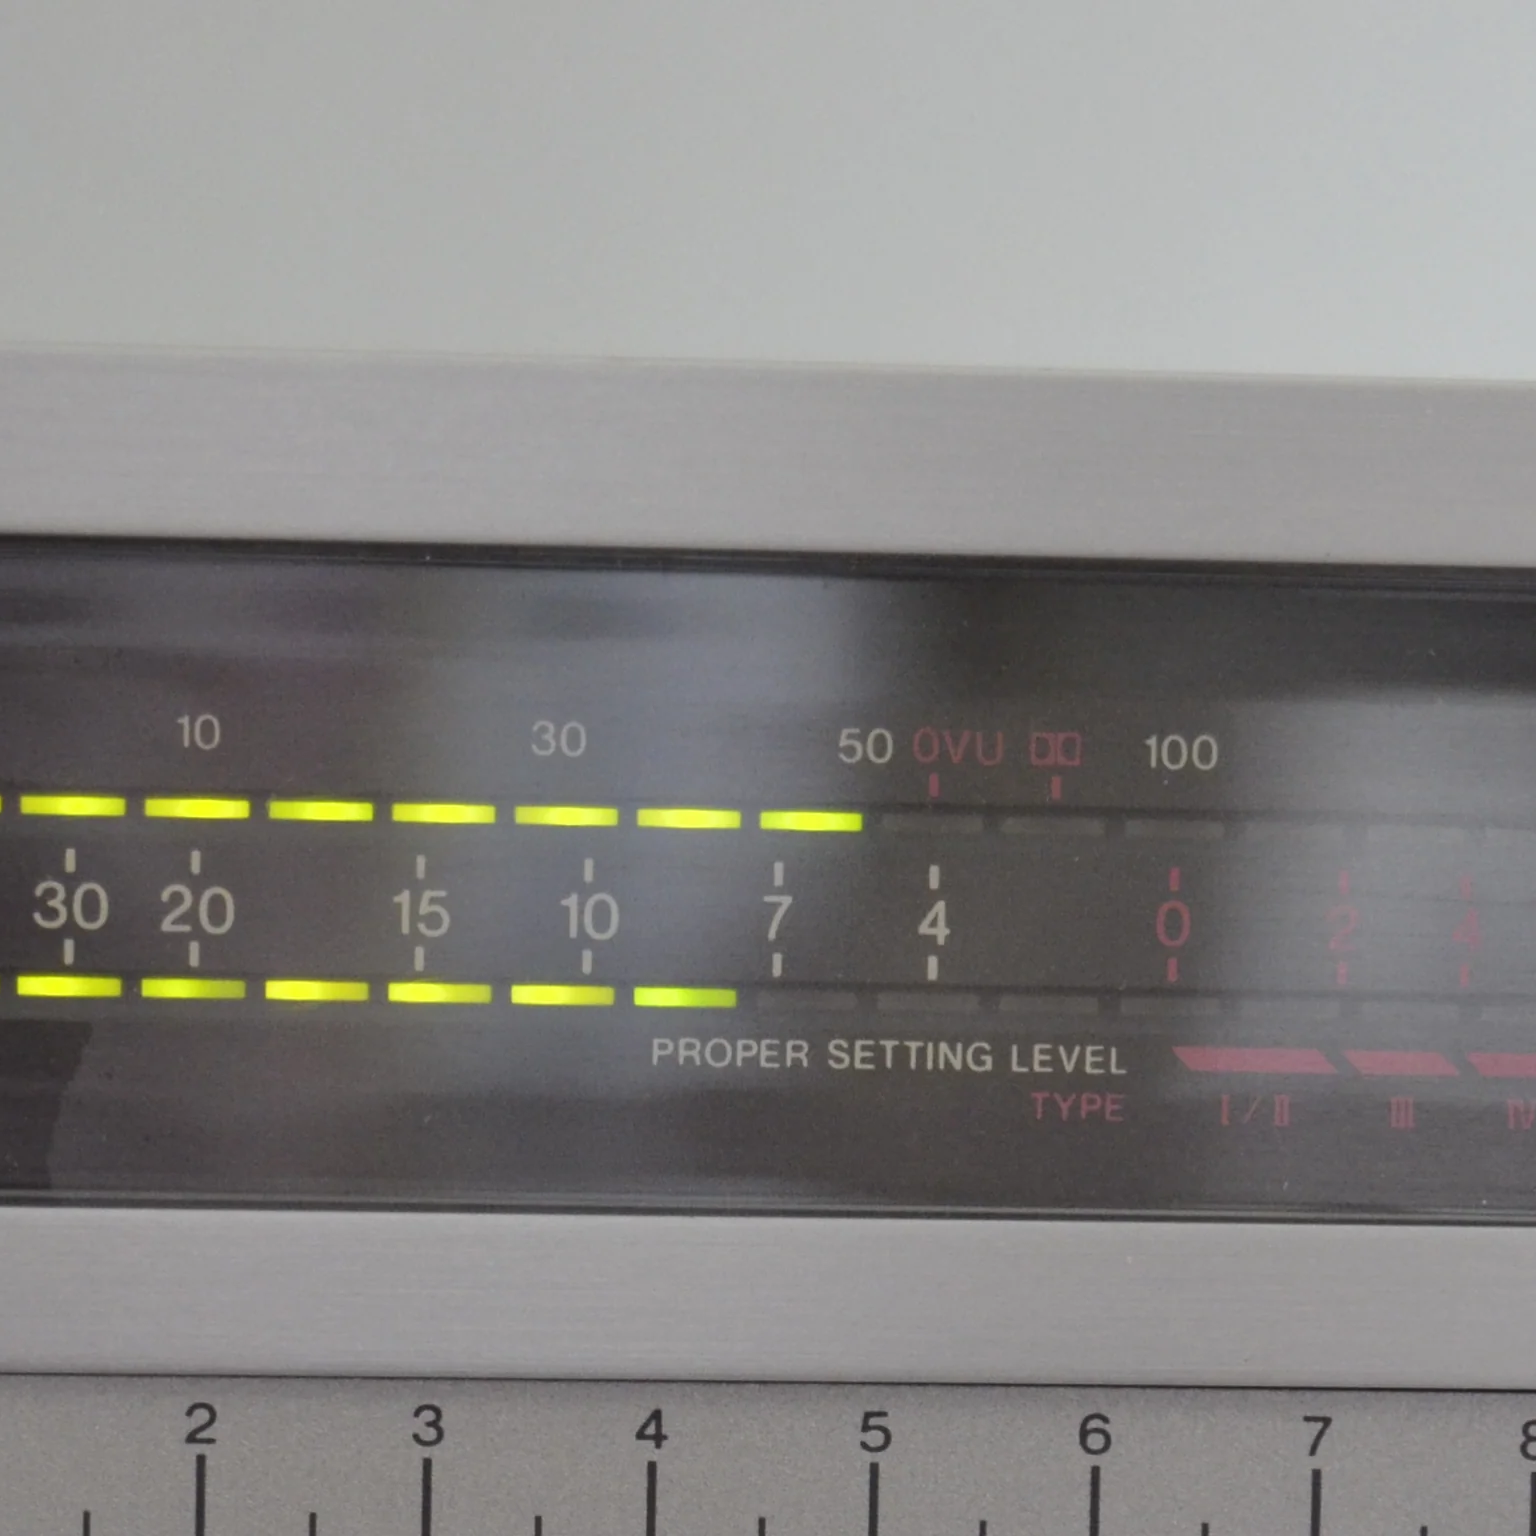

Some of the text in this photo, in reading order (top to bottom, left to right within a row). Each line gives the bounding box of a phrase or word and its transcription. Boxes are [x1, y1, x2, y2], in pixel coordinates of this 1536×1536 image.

[176, 713, 221, 751] 10
[531, 719, 587, 758] 30
[837, 726, 893, 764] 50
[1145, 733, 1219, 771] 100
[33, 879, 109, 930] 30
[160, 883, 235, 935] 20
[393, 889, 451, 938] 15
[560, 892, 620, 941] 10
[762, 894, 793, 941] 7
[918, 899, 951, 946] 4
[1155, 899, 1192, 949] 0
[651, 1036, 1127, 1075] PROPER SETTING LEVEL
[1030, 1090, 1122, 1123] TYPE
[184, 1401, 218, 1445] 2
[411, 1403, 445, 1448] 3
[635, 1407, 669, 1450] 4
[859, 1409, 892, 1453] 5
[1078, 1412, 1112, 1456] 6
[1302, 1415, 1333, 1457] 7
